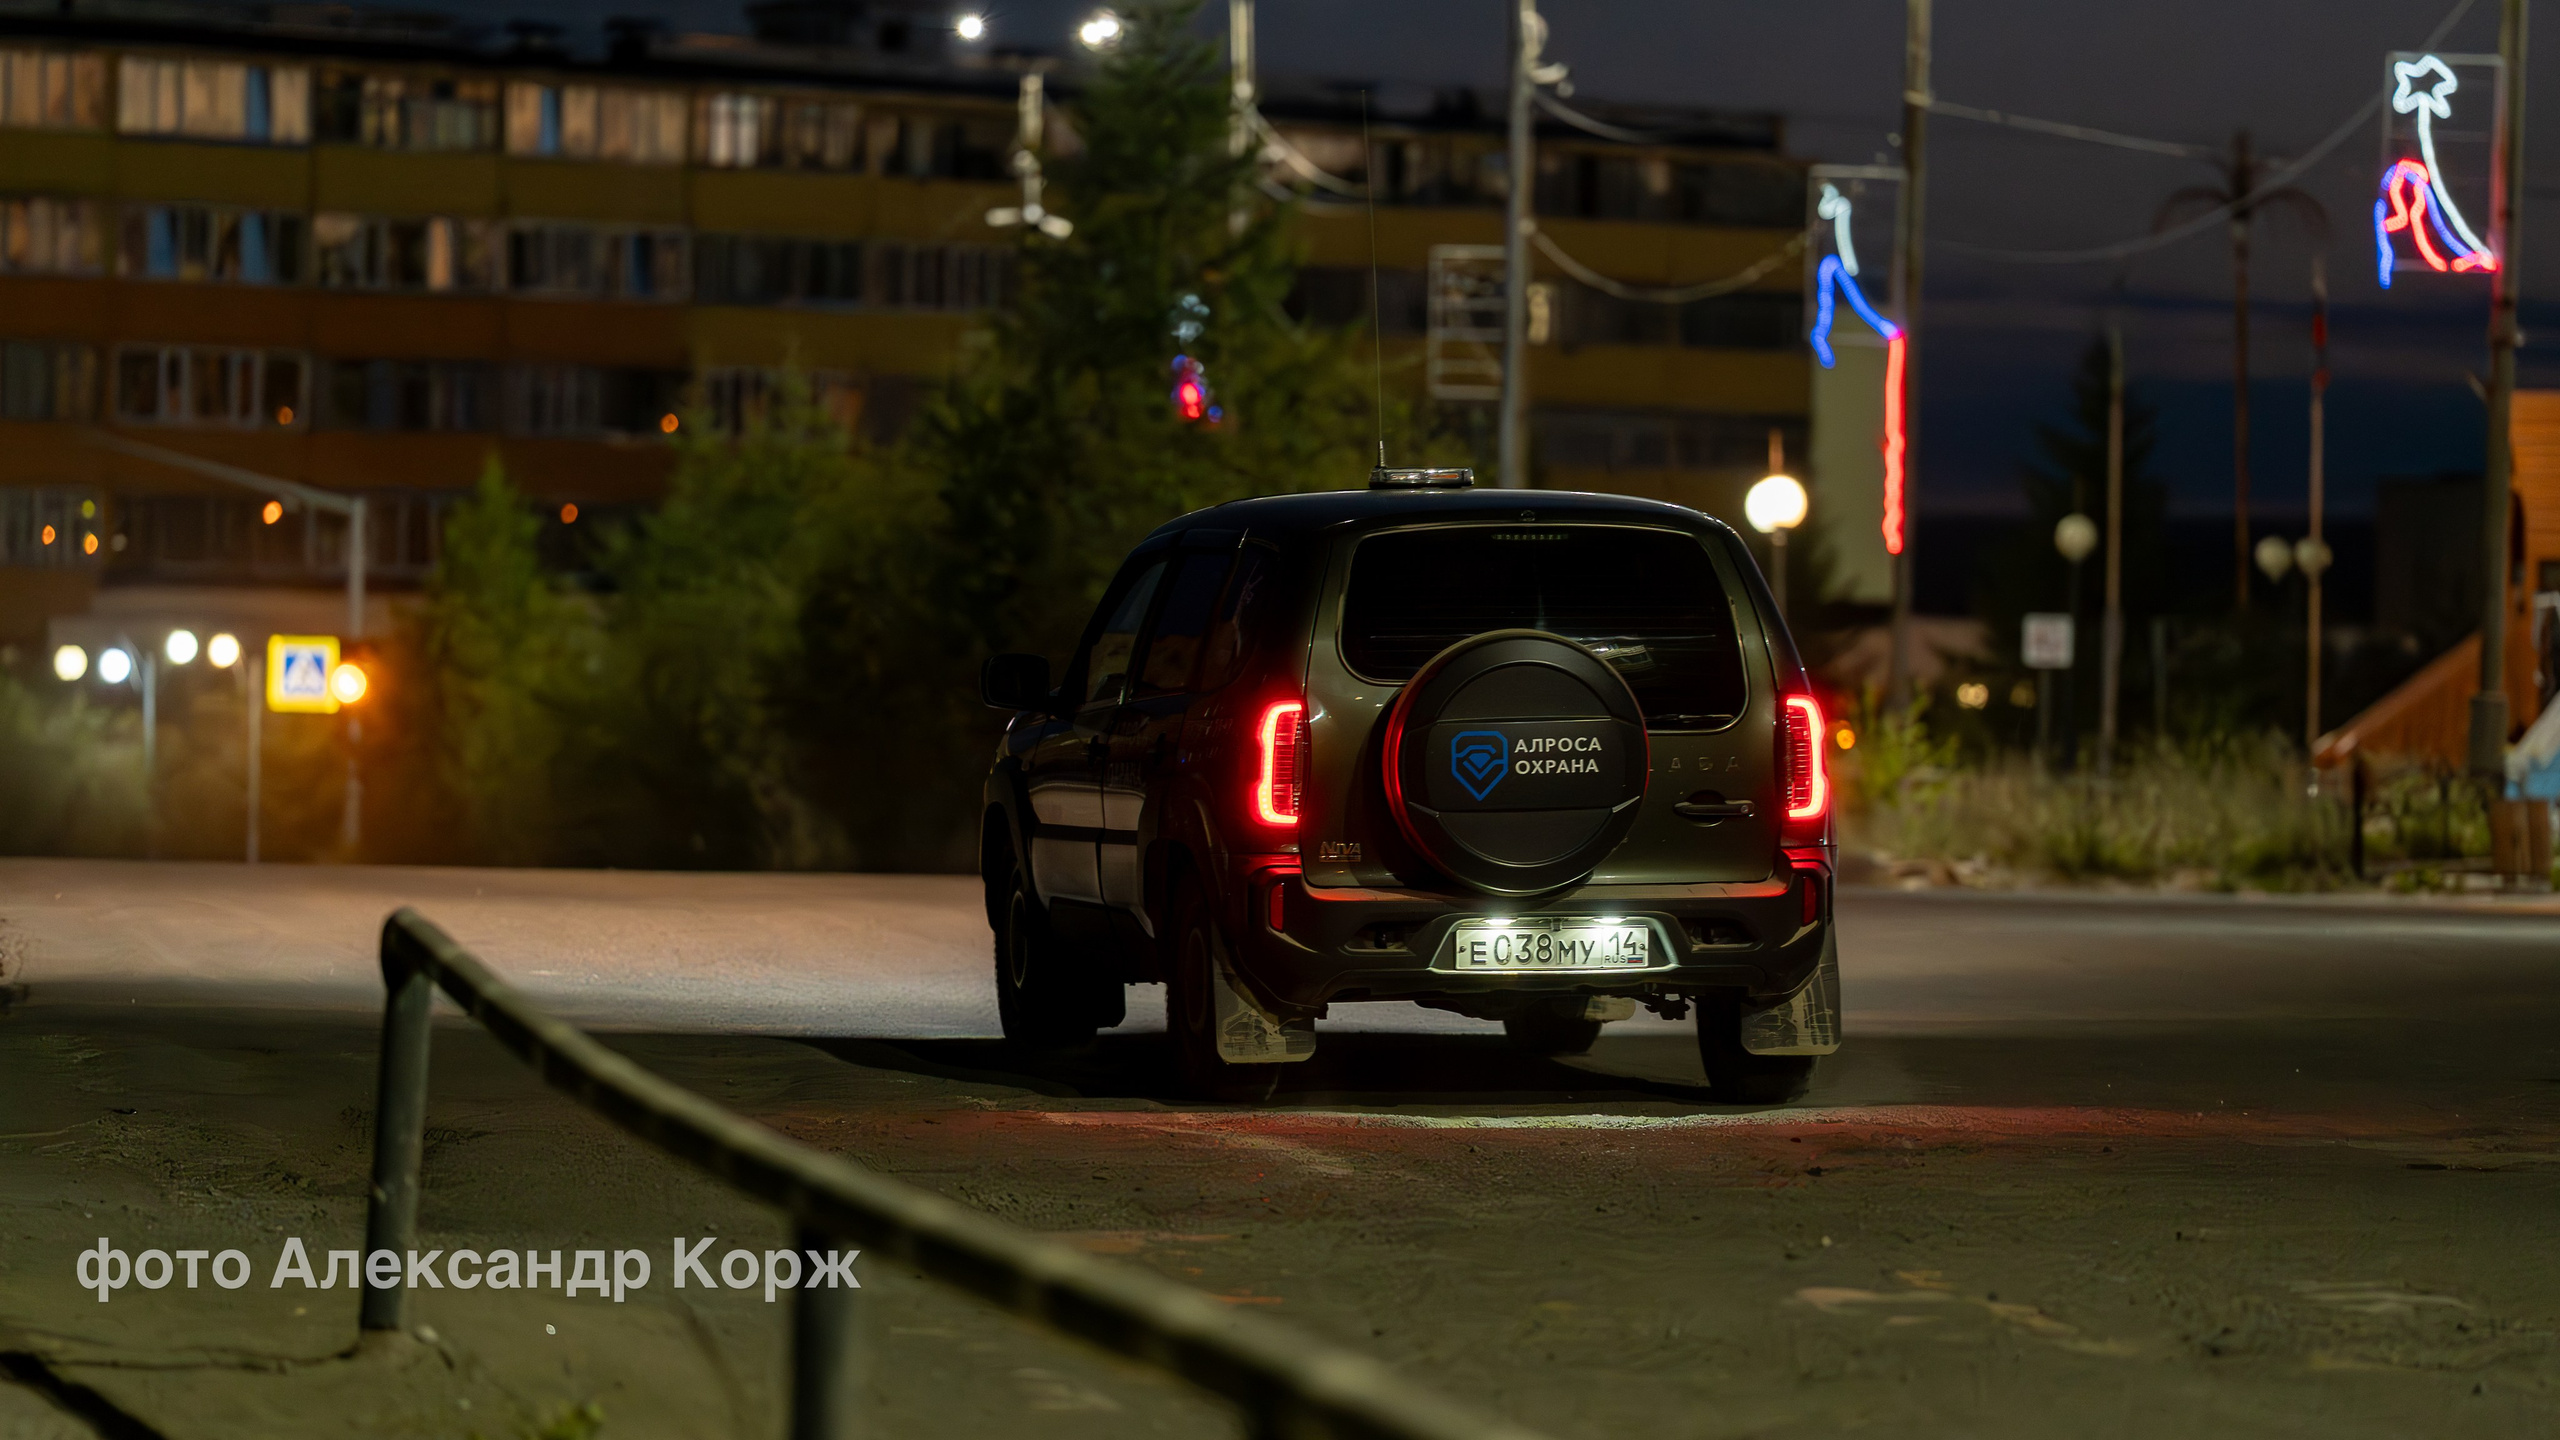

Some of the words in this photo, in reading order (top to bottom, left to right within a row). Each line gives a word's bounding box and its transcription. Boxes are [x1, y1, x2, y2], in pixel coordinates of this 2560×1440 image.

[1514, 737, 1602, 753] АЛРОСА
[1515, 758, 1600, 775] ОХРАНА
[1648, 755, 1739, 773] ADA
[1608, 931, 1638, 956] 14
[1604, 955, 1626, 964] RUS
